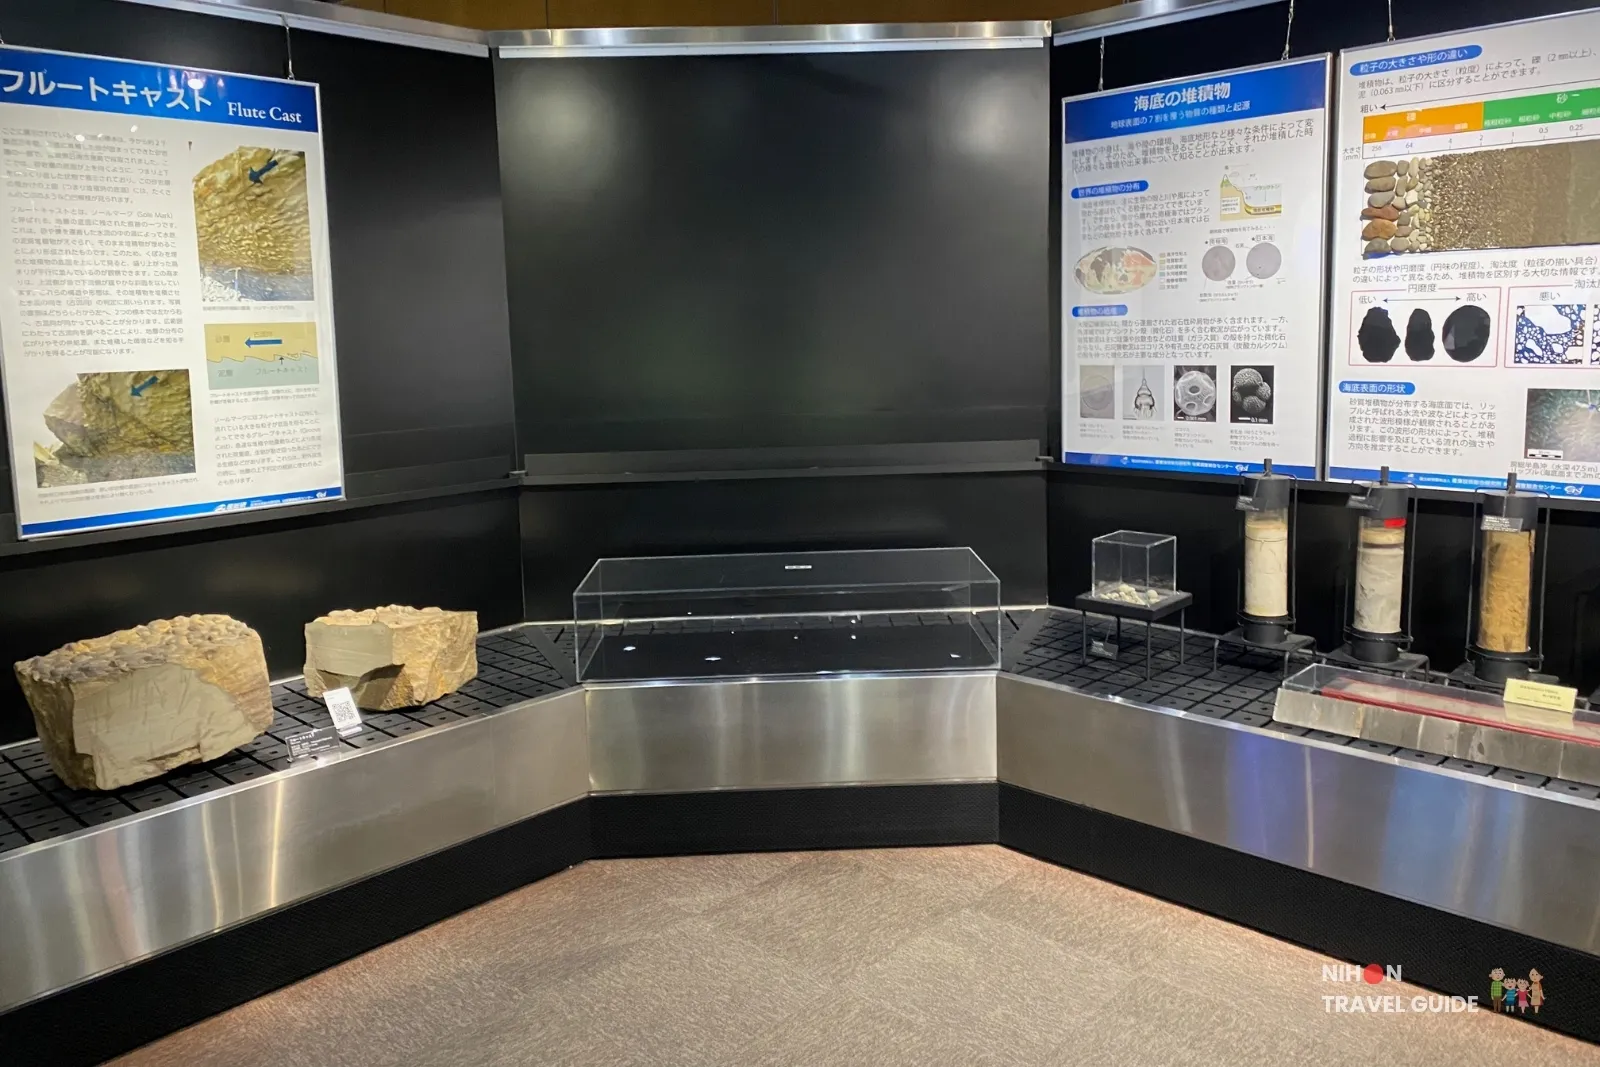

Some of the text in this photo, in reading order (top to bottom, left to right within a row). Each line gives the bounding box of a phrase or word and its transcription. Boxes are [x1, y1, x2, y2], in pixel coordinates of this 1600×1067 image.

[1360, 48, 1467, 74] 粒子の大きさや形の違い
[0, 69, 302, 124] フルートキャスト Flute Cast
[1134, 82, 1231, 112] 海底の堆積物
[1569, 124, 1584, 132] 0.25
[1407, 283, 1437, 293] 円磨度
[1358, 292, 1487, 304] 低い 高い
[1343, 383, 1406, 394] 海底表面の形状
